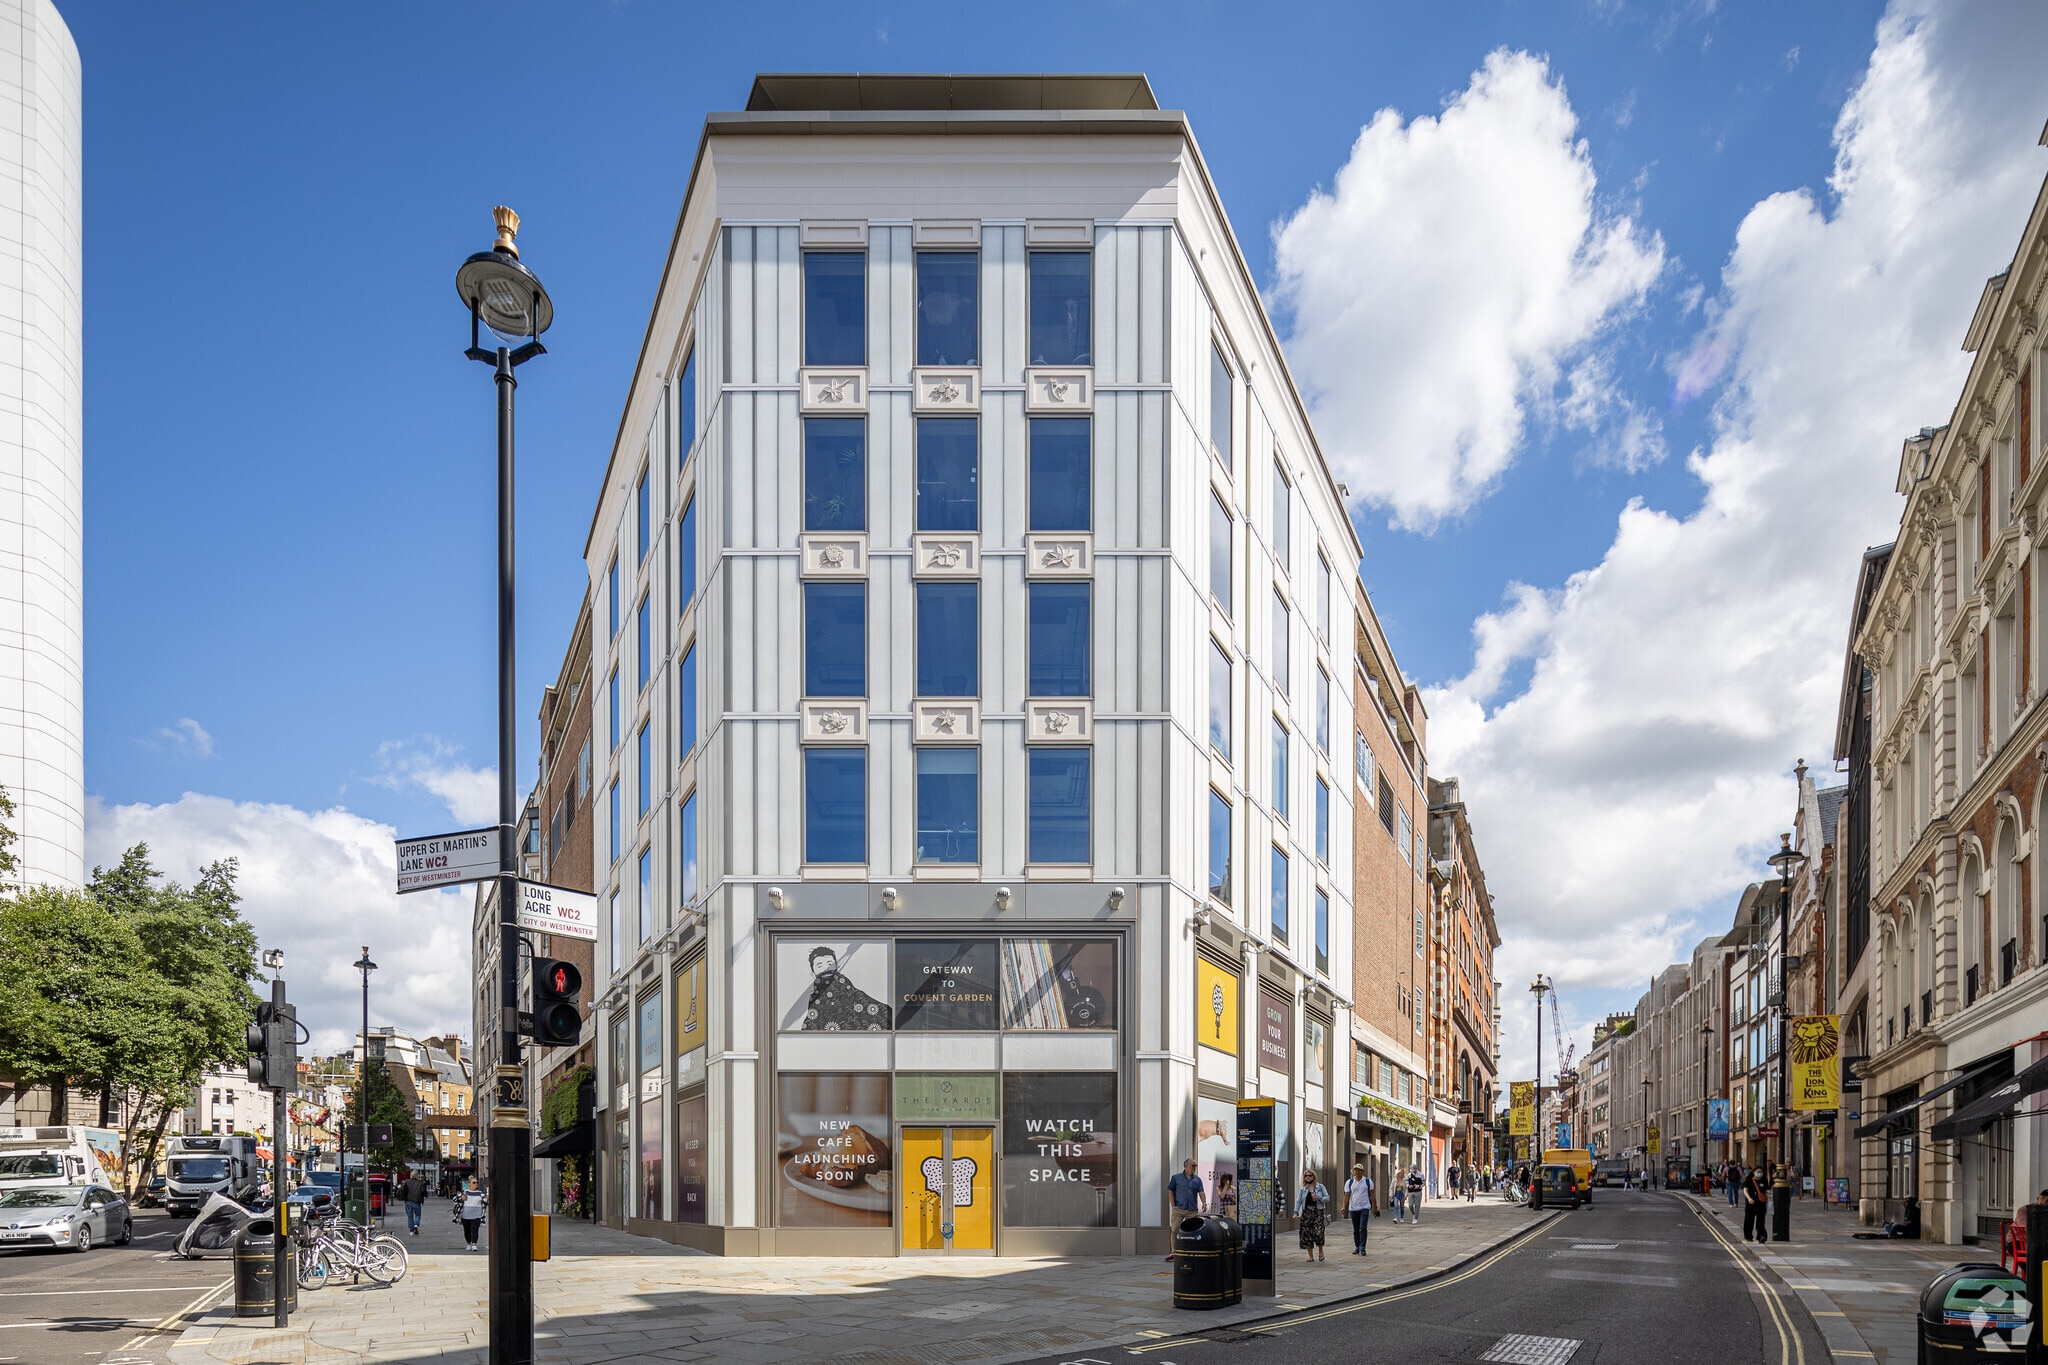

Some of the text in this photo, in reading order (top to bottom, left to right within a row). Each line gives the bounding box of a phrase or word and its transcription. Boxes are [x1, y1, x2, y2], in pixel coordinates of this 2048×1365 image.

[400, 835, 488, 858] UPPER ST. MARTIN'S
[400, 855, 448, 872] LANE WC2
[400, 877, 412, 885] CITY
[422, 870, 461, 882] WESTMINSTER
[524, 886, 551, 901] LONG
[525, 900, 581, 920] ACRE WC2
[523, 917, 538, 926] CITY
[550, 922, 594, 936] WESTMINSTER
[923, 966, 973, 974] GATEWAY
[941, 980, 955, 988] TO
[903, 993, 993, 1002] COVENT GARDEN
[1266, 1006, 1282, 1024] GROW
[1267, 1023, 1281, 1040] YOUR
[1262, 1039, 1286, 1059] BUSINESS
[1805, 1077, 1824, 1087] LION
[1803, 1088, 1827, 1099] KING
[819, 1120, 850, 1130] NEW
[1025, 1119, 1094, 1132] WATCH
[817, 1135, 852, 1147] CAFÉ
[1037, 1144, 1083, 1157] THIS
[794, 1154, 875, 1164] LAUNCHING
[815, 1171, 854, 1181] SOON
[1029, 1168, 1091, 1182] SPACE
[687, 1192, 697, 1202] BACK
